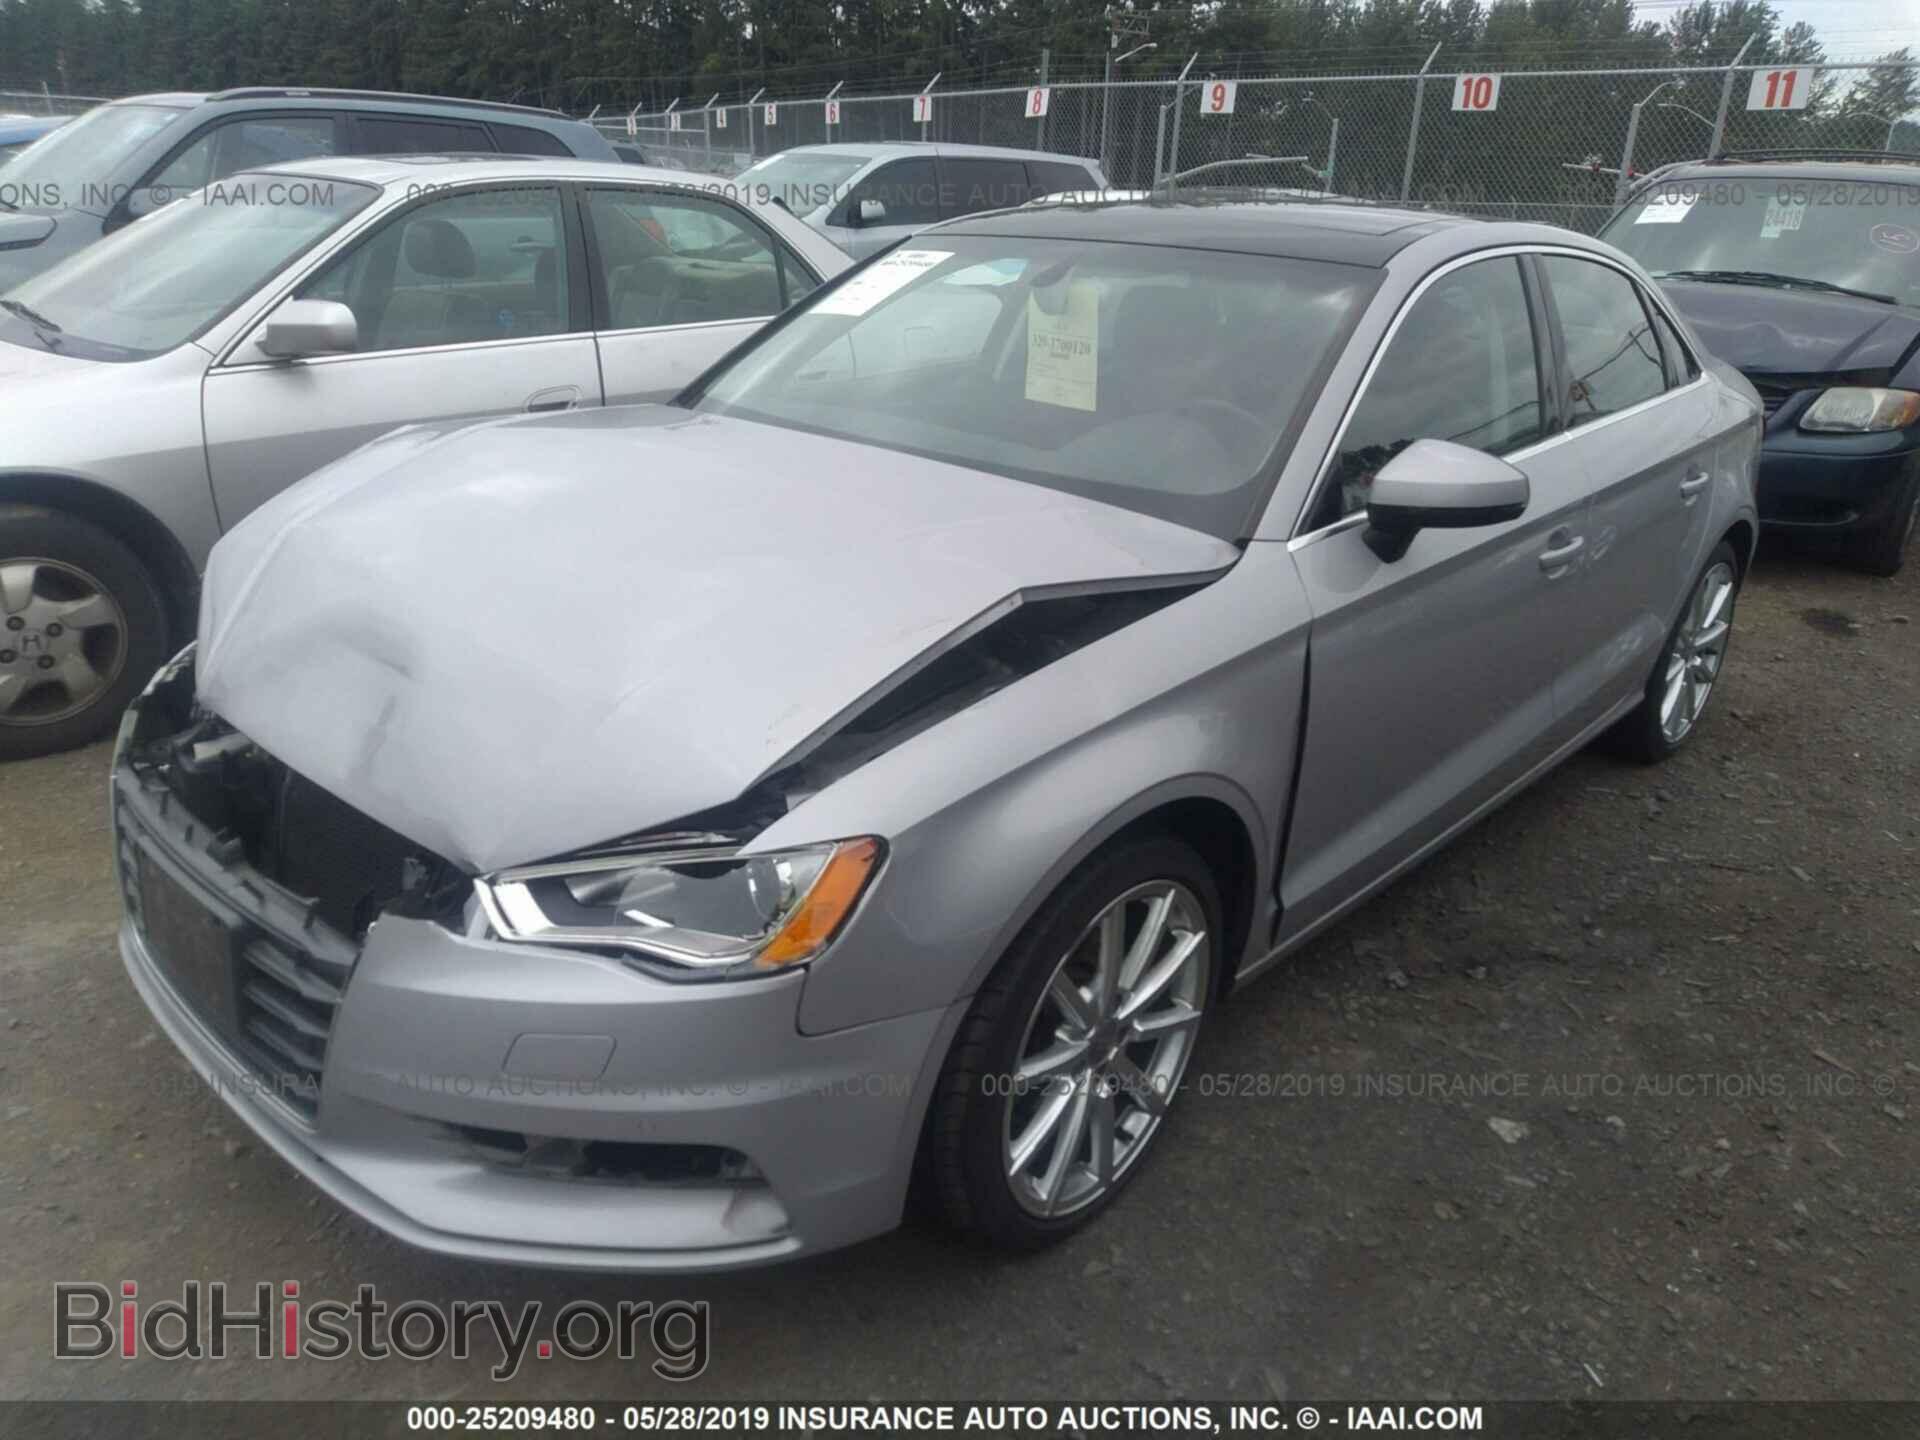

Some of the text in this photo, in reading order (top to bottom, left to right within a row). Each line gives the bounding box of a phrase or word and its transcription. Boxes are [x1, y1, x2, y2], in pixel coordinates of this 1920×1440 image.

[1031, 89, 1042, 115] 8
[1210, 82, 1226, 112] 9
[1461, 76, 1493, 110] 10
[1764, 70, 1798, 108] 11
[829, 103, 837, 123] 6
[918, 96, 927, 121] 7
